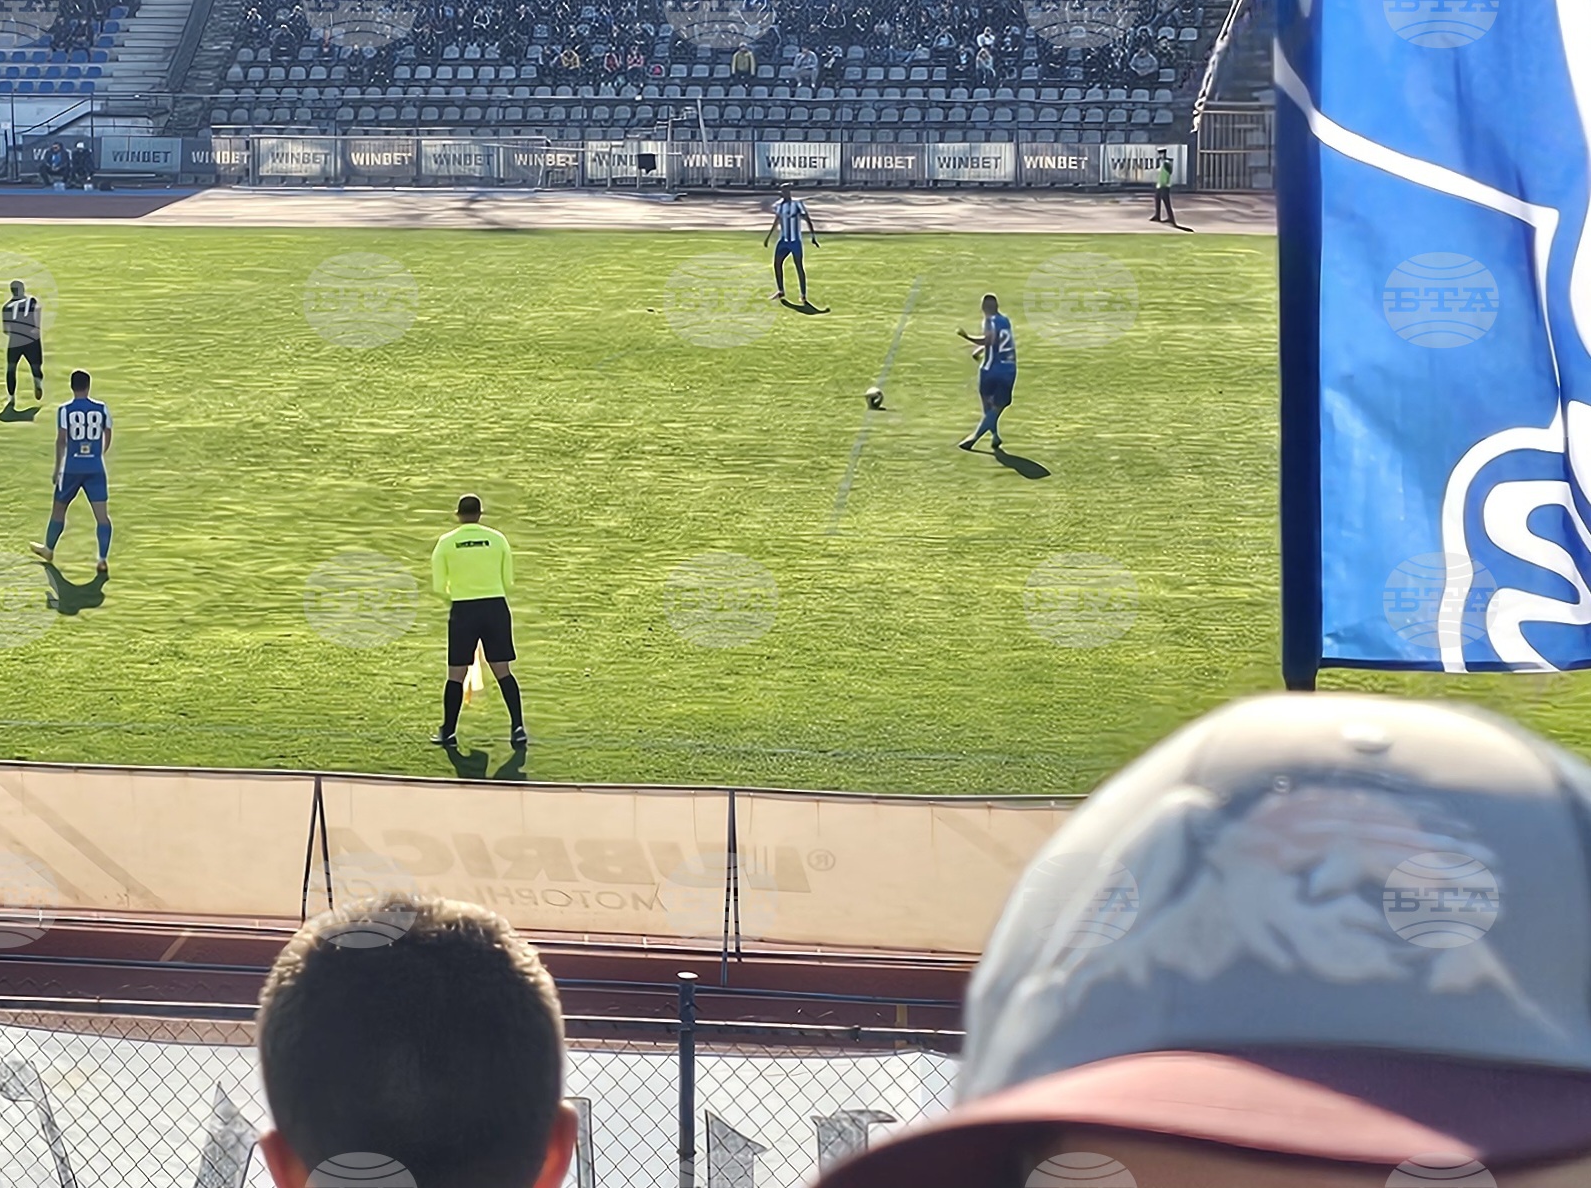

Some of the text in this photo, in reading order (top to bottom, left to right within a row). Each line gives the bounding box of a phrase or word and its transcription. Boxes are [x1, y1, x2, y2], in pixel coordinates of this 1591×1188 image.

[111, 150, 171, 164] WINBET
[191, 150, 251, 165] WINBET
[270, 151, 331, 165] WINBET
[350, 151, 412, 166] WINBET
[683, 154, 745, 168] WINBET
[765, 155, 828, 169] WINBET
[851, 155, 915, 169] WINBET
[937, 156, 1002, 170] WINBET
[1023, 155, 1088, 170] WINBET
[69, 411, 103, 442] 88
